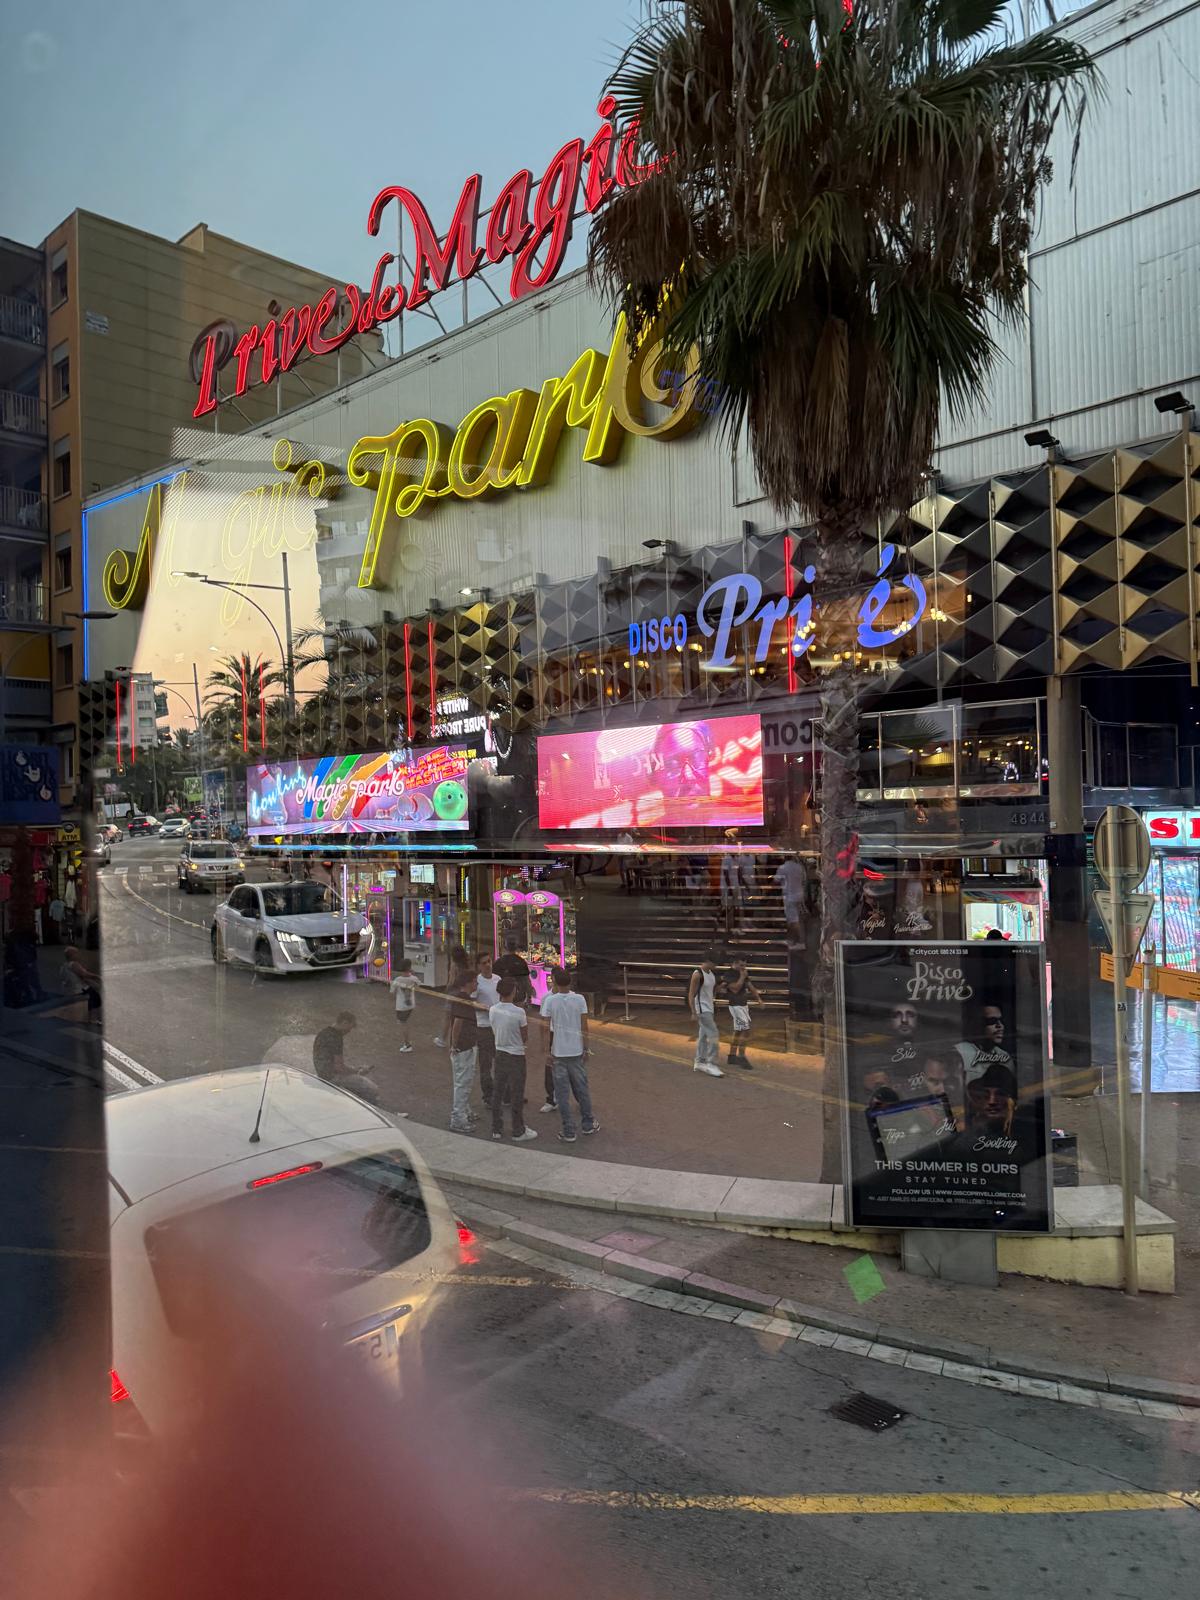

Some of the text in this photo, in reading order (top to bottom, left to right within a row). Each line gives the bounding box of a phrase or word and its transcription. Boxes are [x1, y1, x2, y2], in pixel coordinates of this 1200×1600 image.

[367, 95, 678, 300] Magic
[629, 543, 927, 668] DISCO Prié
[295, 774, 348, 813] Magic
[62, 833, 77, 841] ATM
[915, 961, 963, 983] Disco
[906, 978, 973, 1001] Privé
[874, 1160, 1018, 1175] THIS SUMMER IS OURS
[905, 1176, 987, 1185] STAY TUNED
